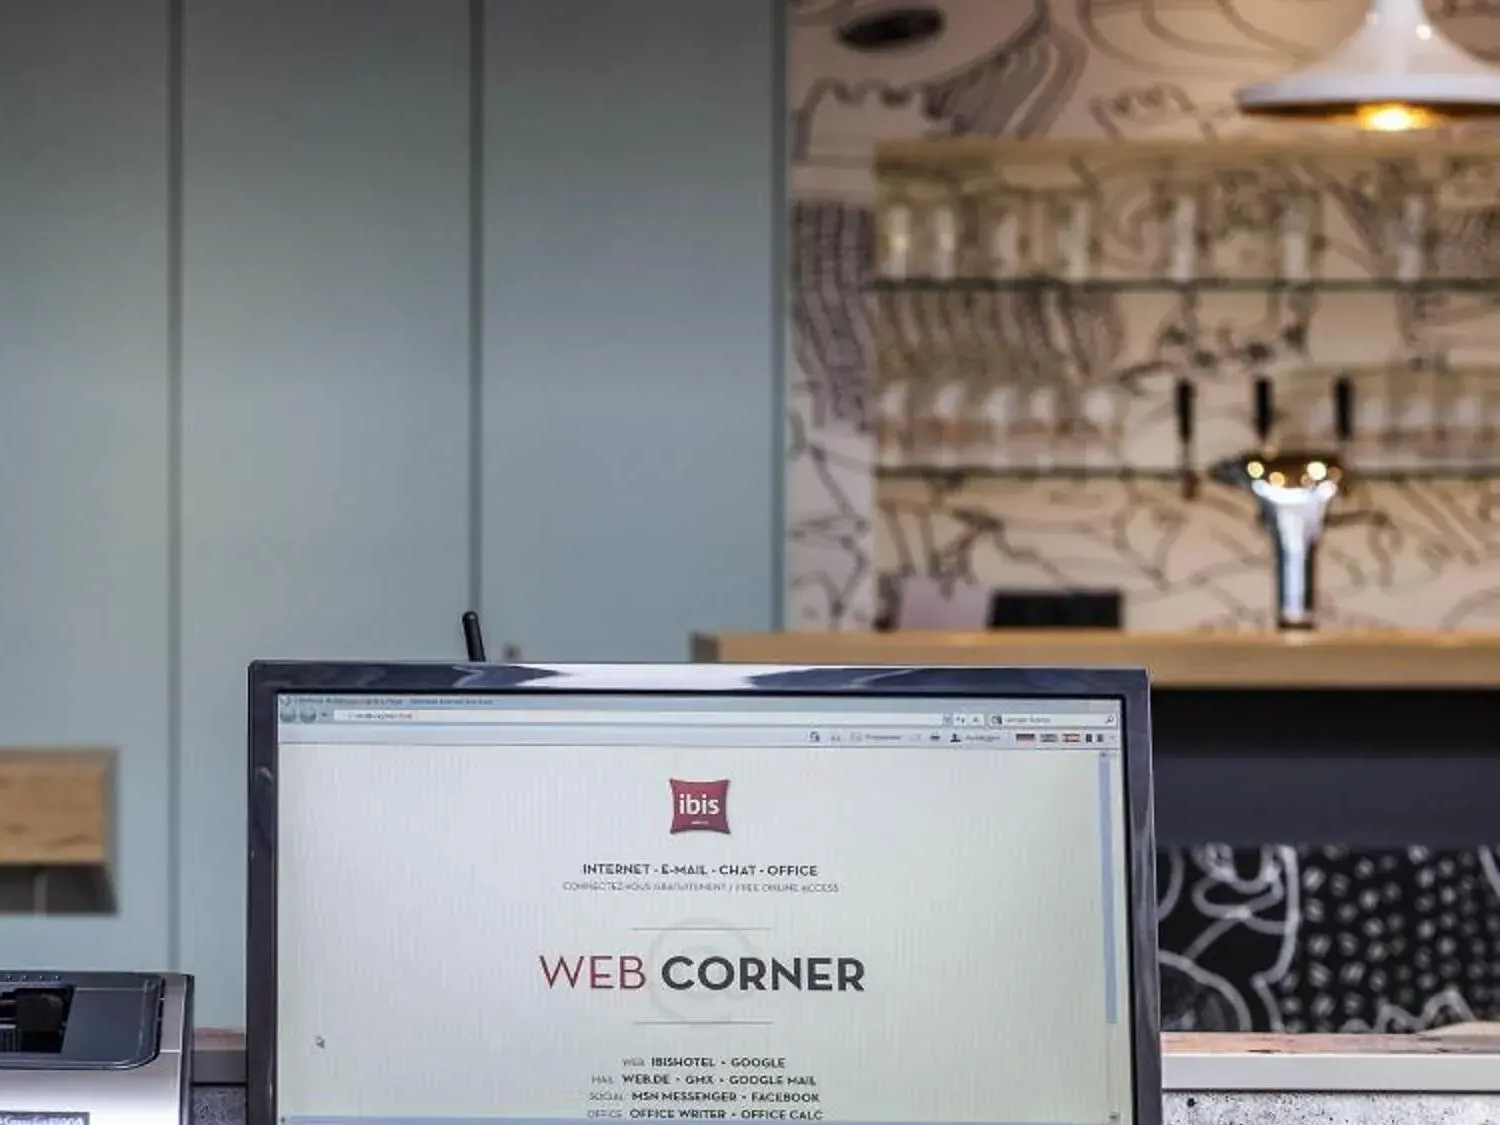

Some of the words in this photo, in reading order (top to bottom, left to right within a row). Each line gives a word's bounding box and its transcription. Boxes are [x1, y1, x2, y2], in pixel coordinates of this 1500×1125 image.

[679, 793, 720, 815] ibis
[583, 863, 651, 875] INTERNET
[661, 864, 708, 875] E-MAIL
[719, 865, 756, 876] CHAT
[767, 865, 818, 876] OFFICE
[540, 955, 646, 990] WEB
[661, 956, 866, 992] CORNER
[651, 1057, 716, 1068] IBISHOTEL
[731, 1057, 786, 1069] GOOGLE
[729, 1075, 784, 1085] GOOGLE
[632, 1091, 659, 1101] MSN
[661, 1091, 737, 1102] MESSENGER
[751, 1092, 820, 1103] FACEBOOK
[629, 1109, 675, 1119] OFFICE
[678, 1109, 726, 1119] WRITER
[741, 1109, 787, 1119] OFFICE
[789, 1109, 824, 1120] CALC
